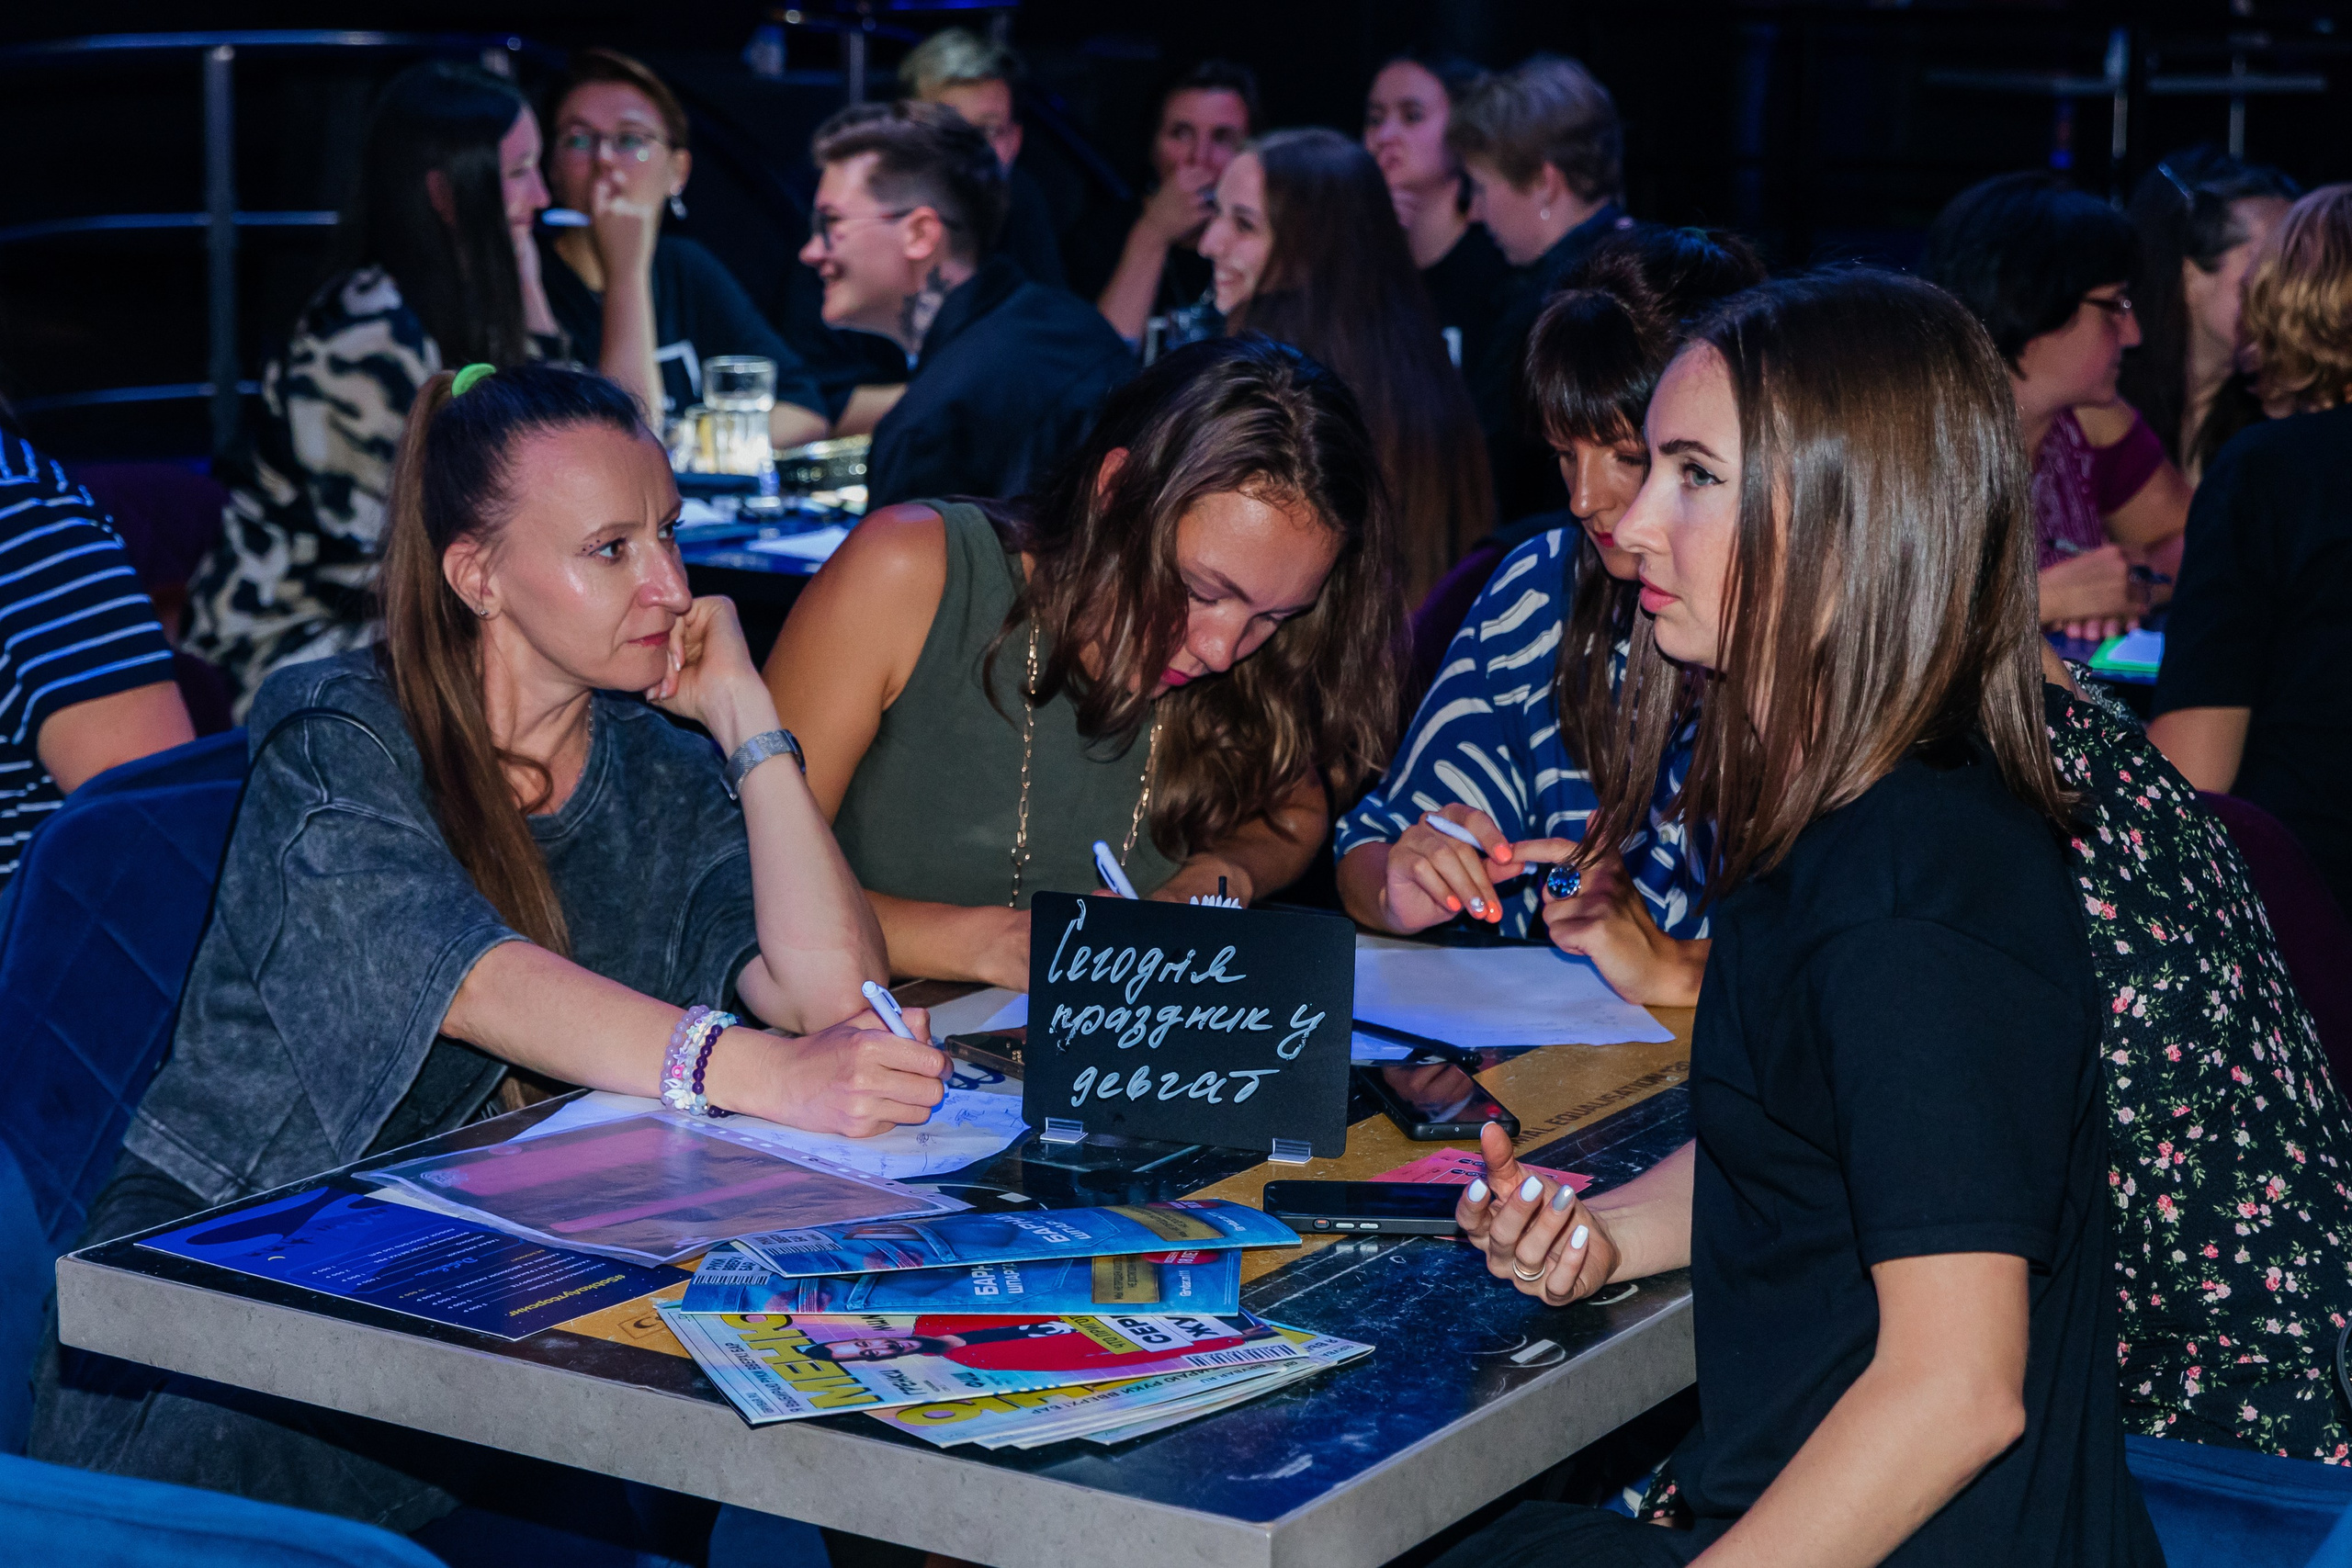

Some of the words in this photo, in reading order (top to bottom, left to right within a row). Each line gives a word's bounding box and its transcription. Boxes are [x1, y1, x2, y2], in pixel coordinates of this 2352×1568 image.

[1048, 898, 1246, 1004] Сегодня
[1048, 1004, 1272, 1055] праздник
[1277, 1003, 1326, 1060] у
[1544, 1072, 1668, 1127] EQUALISATION
[1102, 1337, 1126, 1349] ЧТО
[1109, 1315, 1172, 1345] СЕР
[1163, 1315, 1220, 1339] ЖУ
